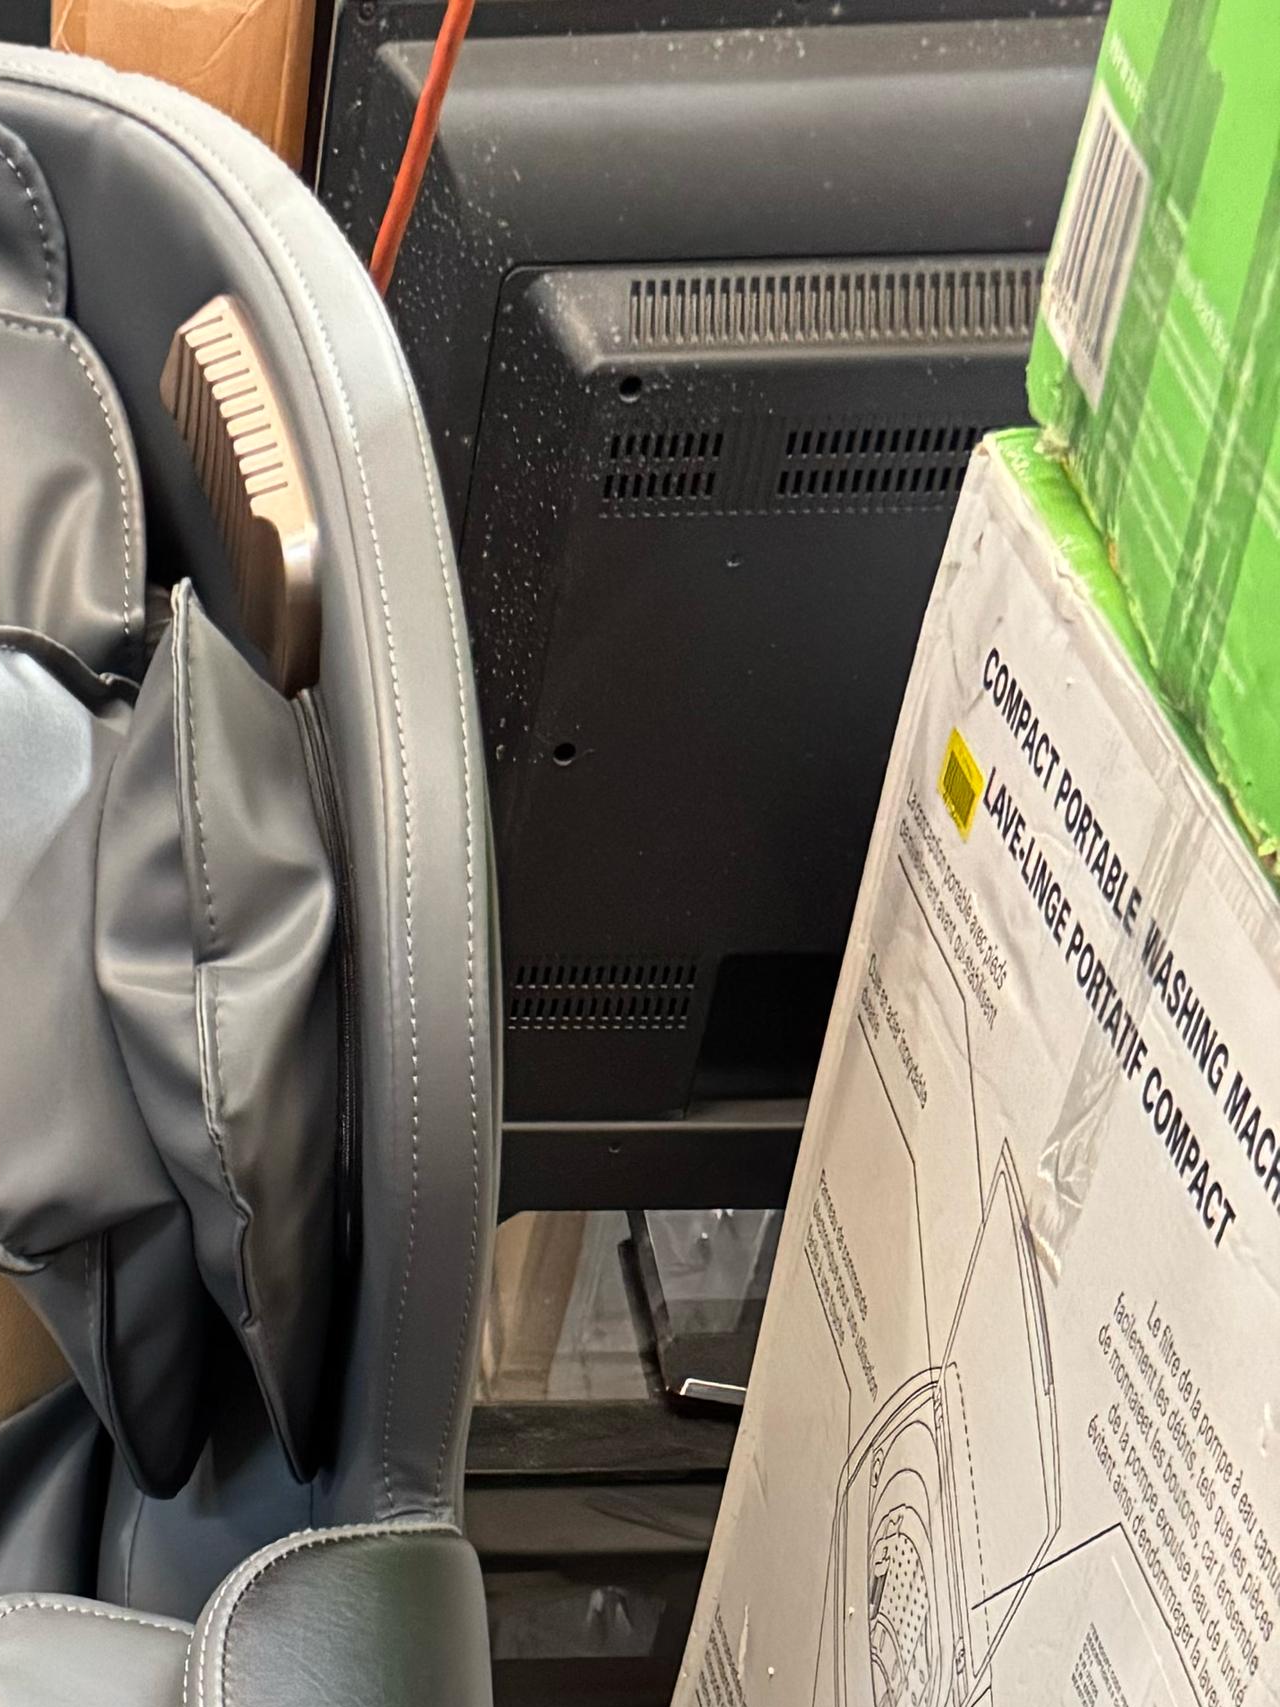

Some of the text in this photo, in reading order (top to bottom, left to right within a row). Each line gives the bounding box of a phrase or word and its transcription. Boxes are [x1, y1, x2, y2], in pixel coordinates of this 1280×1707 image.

[982, 945, 1007, 990] pieds
[983, 648, 1280, 1216] COMPACT PORTABLE WASHING MACH
[983, 766, 1237, 1248] LAVE-LINGE PORTATIF COMPACT
[1087, 1414, 1115, 1481] évitant
[1113, 1474, 1136, 1520] ainsi
[1132, 1515, 1192, 1646] d'endommager
[1190, 1637, 1201, 1670] la
[1098, 1324, 1111, 1355] de
[1149, 1428, 1165, 1468] les
[1163, 1457, 1199, 1547] boutons,
[1201, 1540, 1218, 1575] car
[1214, 1566, 1258, 1675] l'ensemble
[1108, 1403, 1121, 1434] de
[1118, 1422, 1129, 1452] la
[1125, 1446, 1158, 1512] pompe
[1156, 1508, 1190, 1581] expulse
[1188, 1572, 1209, 1624] l'eau
[1206, 1620, 1220, 1651] de
[1114, 1292, 1280, 1641] facilement les débris, tels que les pièces
[1147, 1300, 1161, 1338] Le
[1159, 1325, 1180, 1377] filtre
[1178, 1369, 1193, 1402] de
[1189, 1388, 1201, 1420] la
[1197, 1415, 1232, 1482] pompe
[1231, 1470, 1243, 1498] à
[1238, 1493, 1257, 1534] eau
